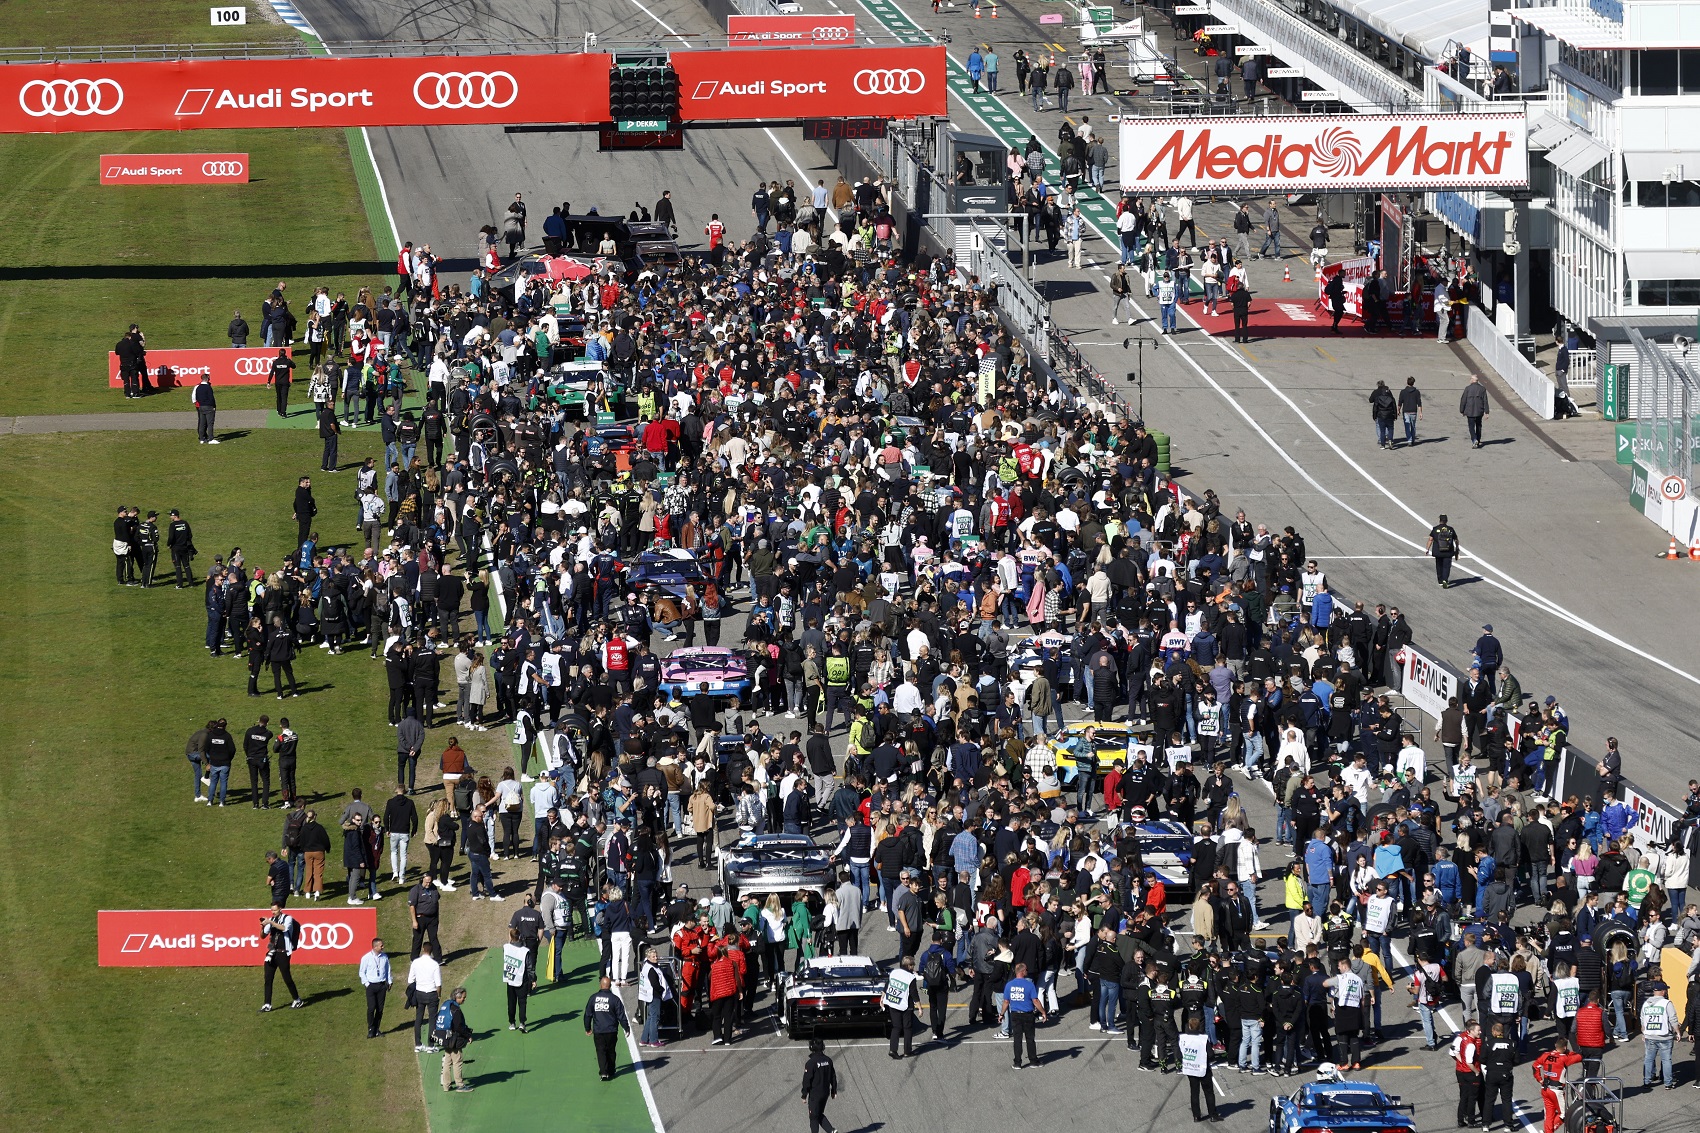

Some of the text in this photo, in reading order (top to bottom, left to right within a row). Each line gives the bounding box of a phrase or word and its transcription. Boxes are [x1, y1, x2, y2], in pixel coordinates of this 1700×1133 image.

[216, 10, 240, 23] 100
[773, 32, 802, 41] Sport
[719, 79, 826, 97] Audi Sport
[215, 87, 373, 113] Audi Sport
[812, 120, 884, 139] 13:16:24
[1136, 125, 1512, 180] Media Markt
[121, 166, 183, 178] Audi Sport
[975, 234, 979, 248] 1
[169, 364, 211, 378] Sport
[1665, 482, 1680, 494] 60
[1414, 658, 1448, 701] REMUS
[148, 933, 259, 952] Audi Sport
[888, 986, 903, 997] 067
[1500, 993, 1515, 1001] 299
[1645, 1006, 1663, 1015] DEKRA
[1492, 1042, 1509, 1051] ABT
